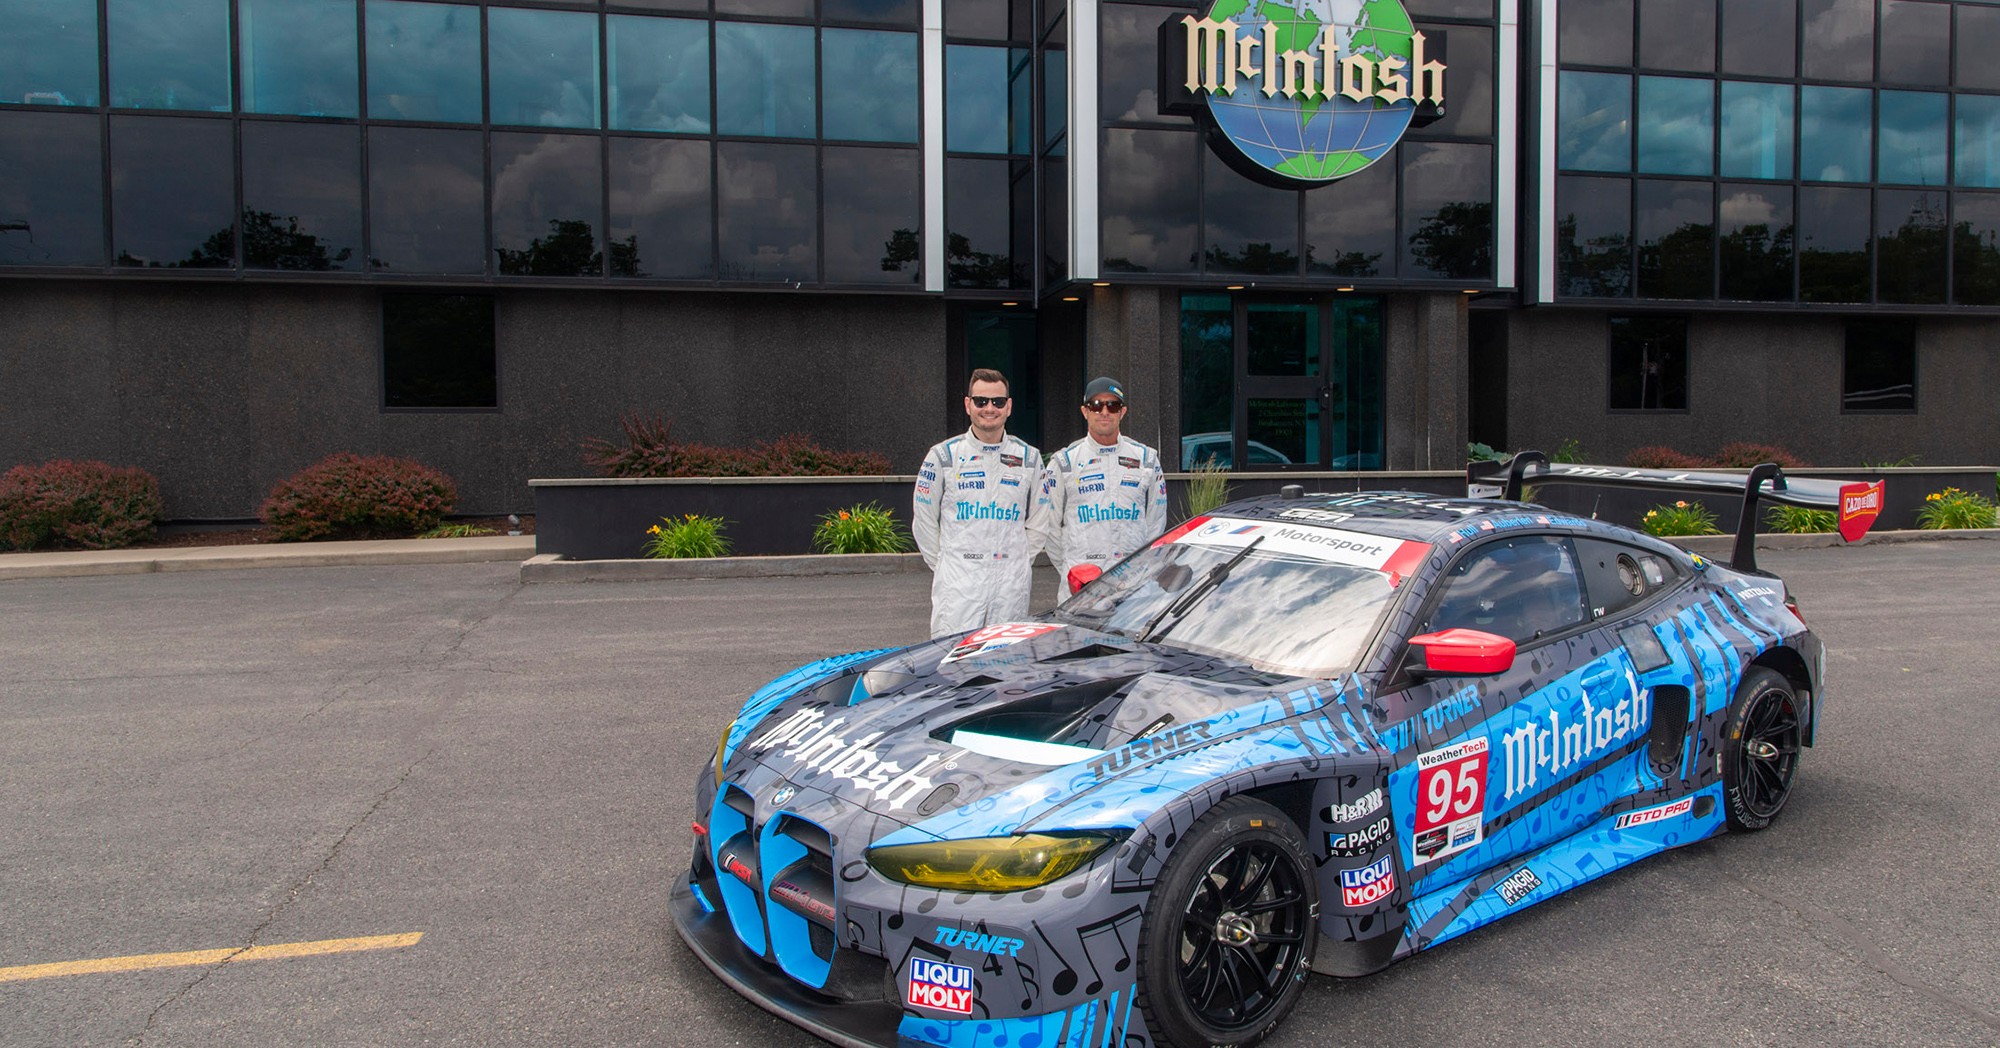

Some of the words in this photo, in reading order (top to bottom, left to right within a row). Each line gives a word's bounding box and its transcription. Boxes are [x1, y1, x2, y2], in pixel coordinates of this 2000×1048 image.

[1181, 14, 1448, 106] McIntosh
[956, 501, 1020, 521] McIntosh
[1077, 501, 1141, 523] McIntosh
[1845, 497, 1861, 514] CAZO
[1273, 527, 1383, 557] Motorsport
[1457, 523, 1479, 540] Hull
[1491, 515, 1534, 528] Auberlen
[972, 624, 1048, 642] 95
[1422, 683, 1482, 735] TURNER
[1502, 668, 1649, 801] McIntosh
[748, 707, 942, 811] McIntosh
[1086, 721, 1213, 781] TURNER
[1420, 740, 1486, 767] WeatherTech
[1427, 758, 1480, 824] 95
[1631, 809, 1662, 824] GTD
[1664, 800, 1690, 817] PRO
[1331, 832, 1392, 857] RACING
[1348, 817, 1390, 848] PAGID
[1344, 857, 1390, 887] LIQUI
[1503, 869, 1535, 895] PAGID
[1346, 875, 1392, 905] MOLY
[1506, 879, 1541, 906] RACING
[933, 926, 1025, 958] TURNER
[913, 960, 970, 989] LIQUI
[911, 983, 971, 1010] MOLY
